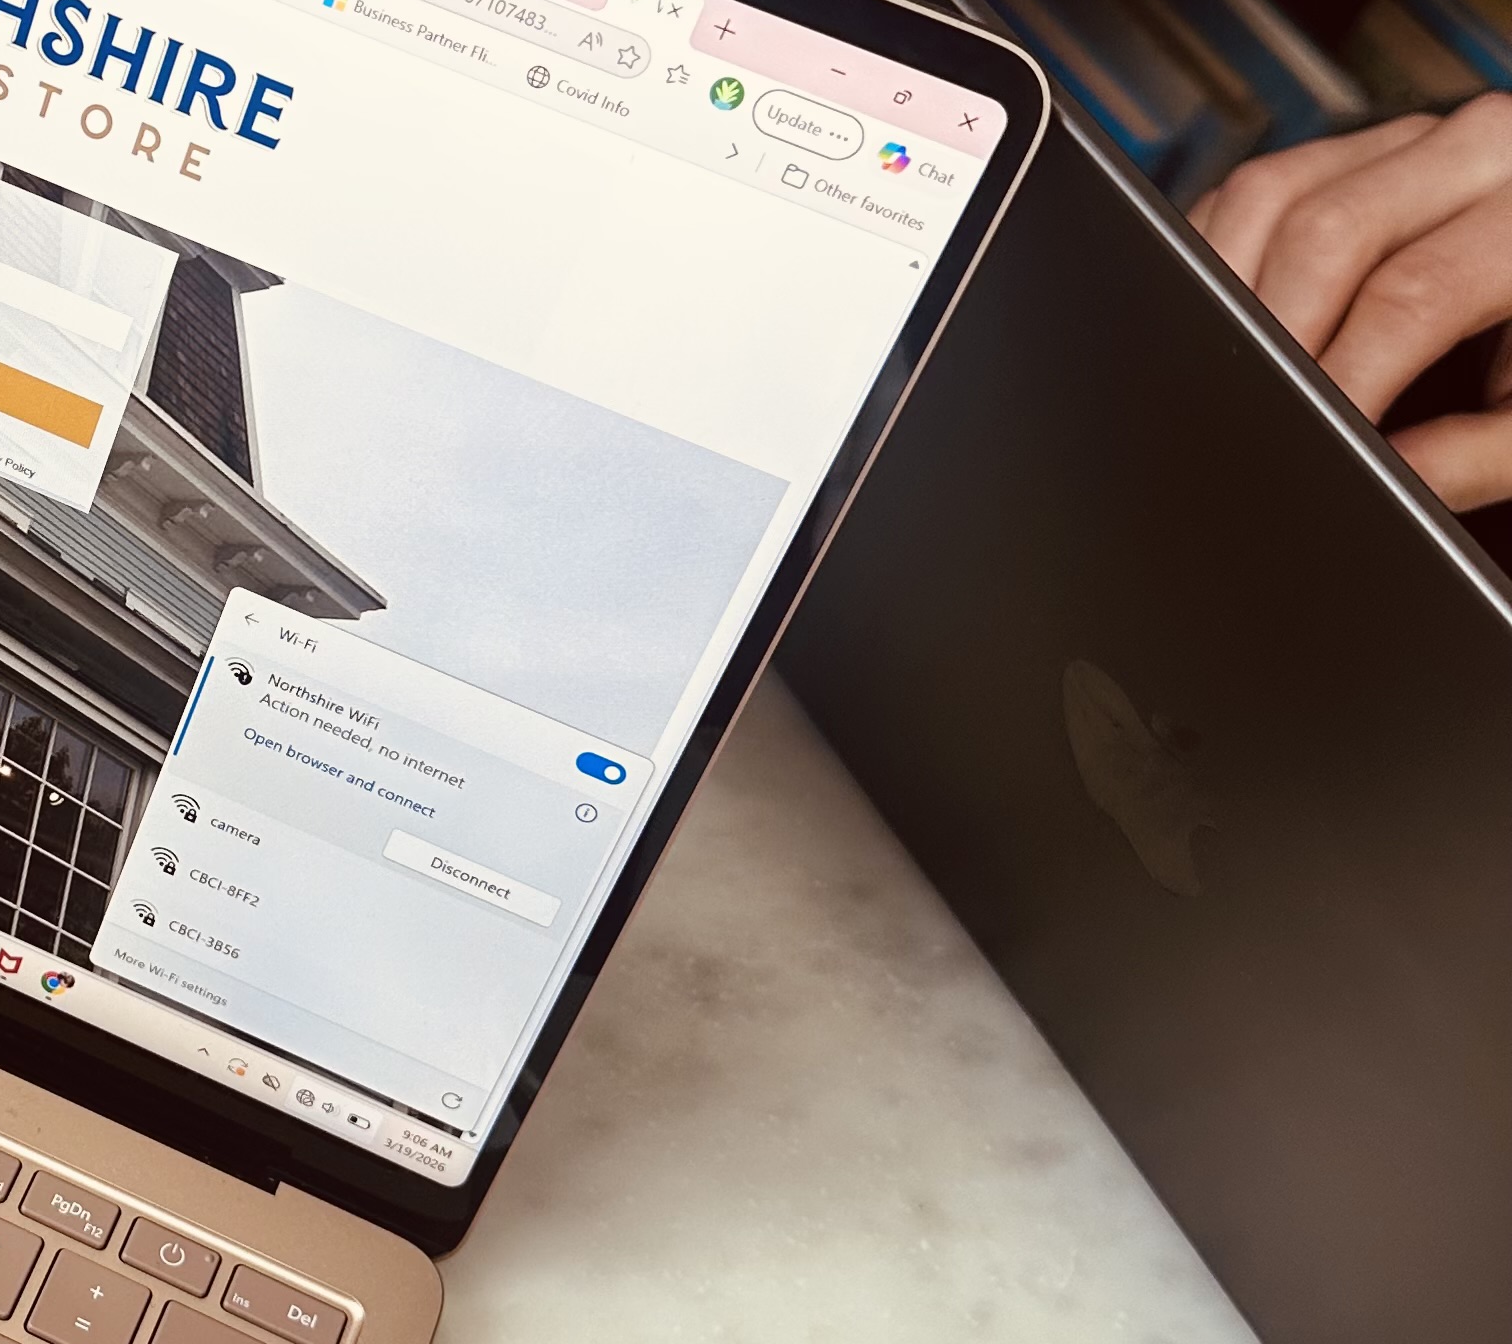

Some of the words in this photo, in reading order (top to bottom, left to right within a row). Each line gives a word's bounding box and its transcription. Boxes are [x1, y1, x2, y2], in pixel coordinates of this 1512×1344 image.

[354, 0, 413, 34] Business
[416, 25, 469, 54] Partner
[557, 79, 598, 104] Covid
[602, 96, 630, 118] Info
[767, 105, 822, 136] Update
[918, 162, 955, 187] Chat
[814, 178, 857, 205] Other
[860, 196, 925, 232] favorites
[4, 455, 36, 479] Policy
[278, 626, 318, 654] Wi-Fi
[268, 673, 345, 715] Northshire
[348, 704, 380, 731] WiFi
[259, 694, 310, 721] Action
[313, 713, 373, 753] needed,
[378, 743, 400, 760] no
[403, 750, 465, 790] internet
[243, 727, 283, 754] Open
[286, 742, 343, 780] browser
[346, 770, 375, 792] and
[377, 785, 436, 819] connect
[210, 817, 261, 848] camera
[189, 868, 260, 908] CBCI-8FF2
[430, 855, 512, 901] Disconnect
[168, 919, 240, 960] CBCI-3B56
[114, 948, 146, 971] More
[148, 960, 179, 985] Wi-Fi
[180, 975, 228, 1007] settings
[402, 1129, 428, 1148] 9:06
[429, 1142, 452, 1159] AM
[50, 1193, 91, 1222] PgDn
[232, 1292, 250, 1307] Ins
[287, 1305, 317, 1329] Del
